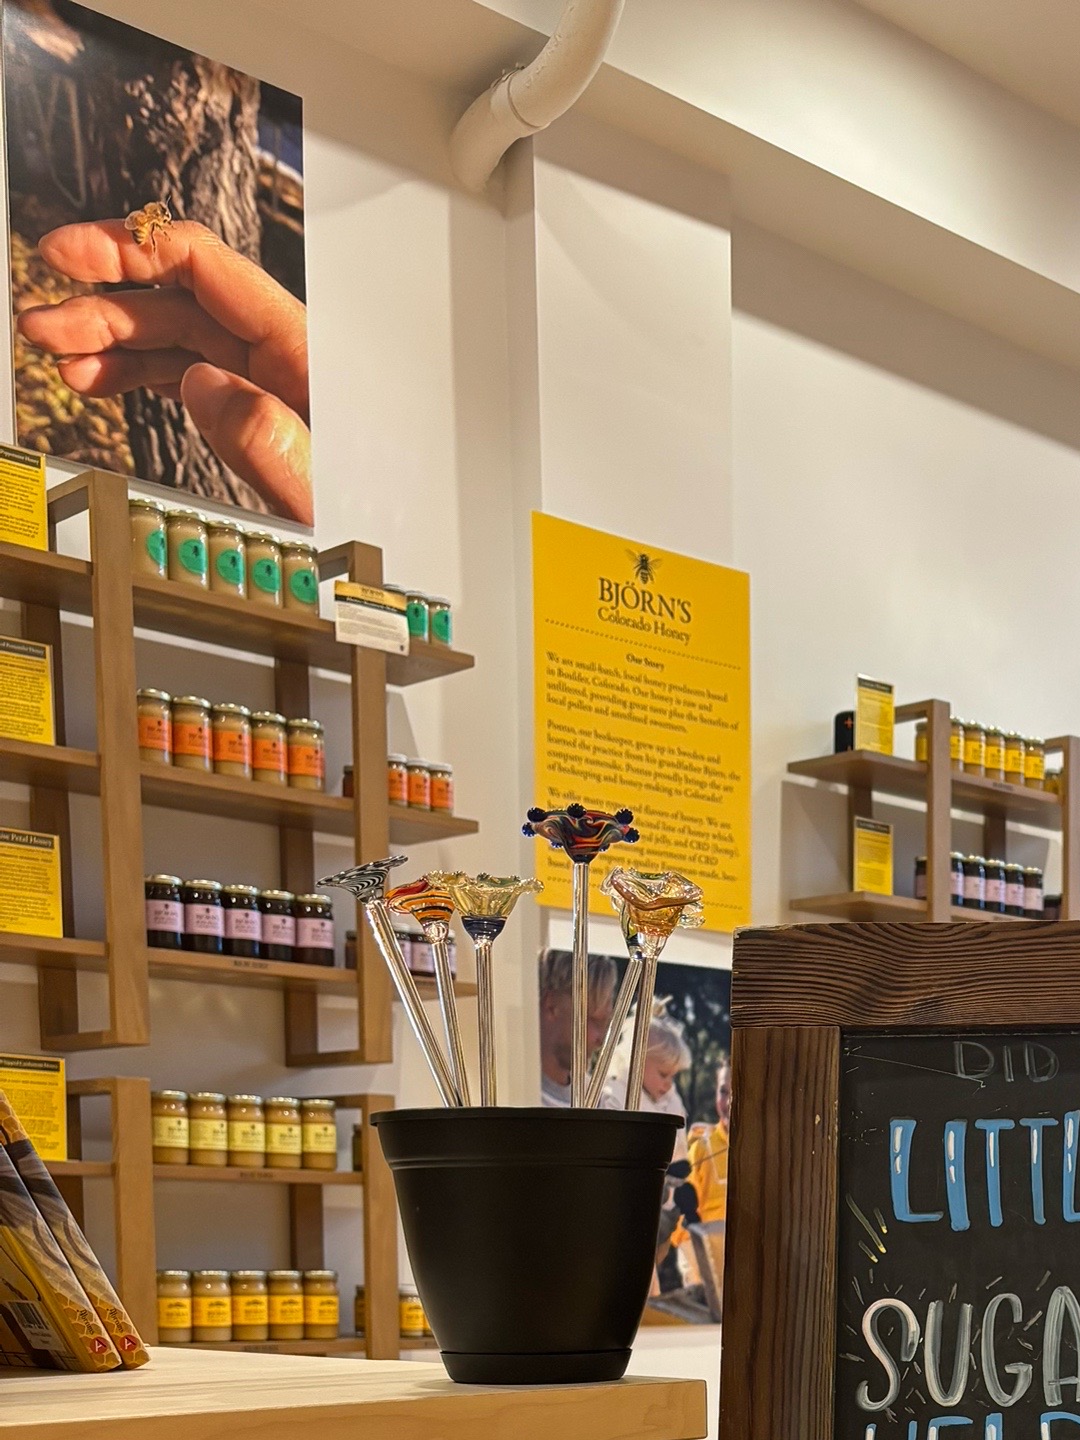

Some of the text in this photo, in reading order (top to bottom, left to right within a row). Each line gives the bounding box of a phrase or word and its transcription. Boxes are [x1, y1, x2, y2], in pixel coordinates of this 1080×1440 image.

[598, 577, 690, 623] BJÖRN'S
[598, 606, 689, 645] Colorado Honey
[546, 650, 559, 662] We
[642, 674, 666, 690] honey
[626, 652, 664, 672] Our Story
[632, 686, 648, 697] Our
[649, 689, 672, 704] honey
[676, 746, 704, 761] Sweden
[953, 1040, 1060, 1082] DID
